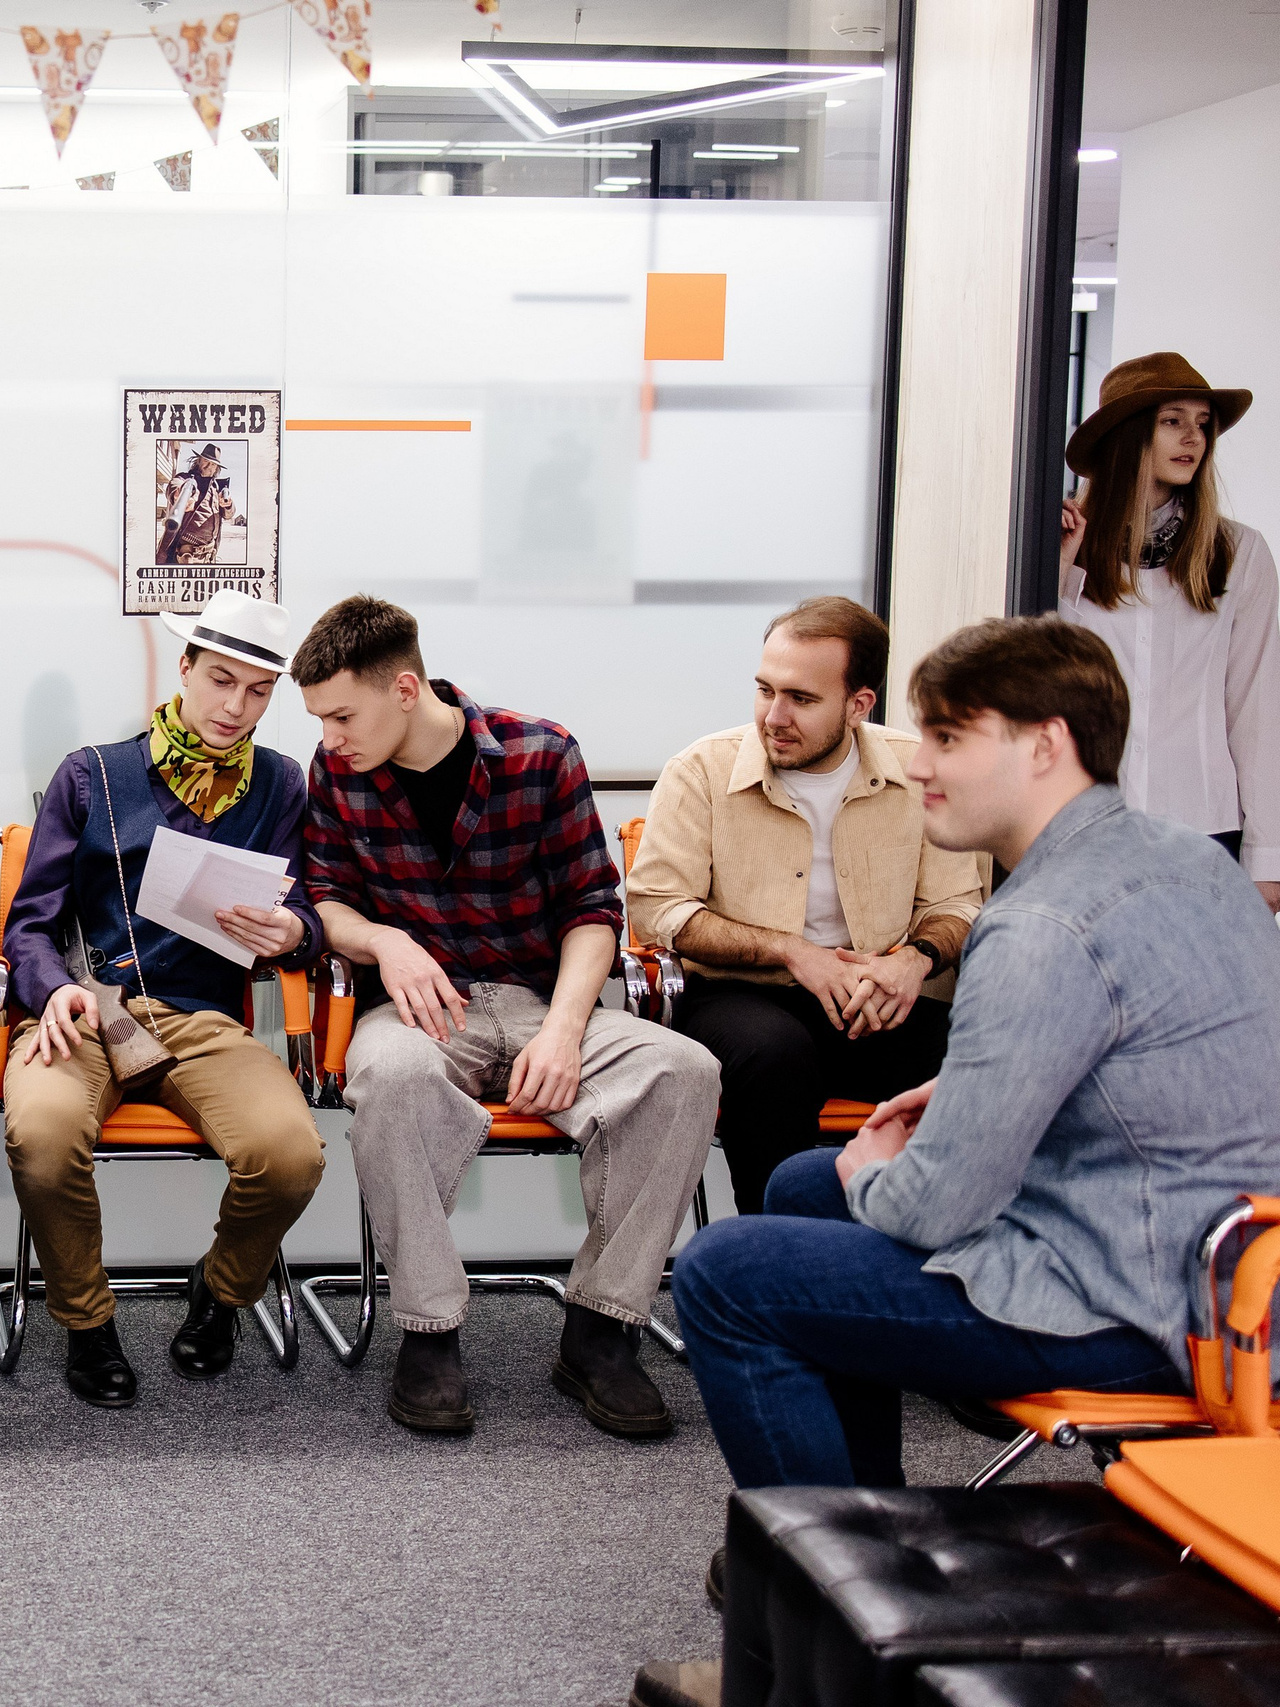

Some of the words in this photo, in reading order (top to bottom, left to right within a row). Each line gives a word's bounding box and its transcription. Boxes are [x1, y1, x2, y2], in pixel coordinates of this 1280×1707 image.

[139, 404, 266, 433] WANTED
[142, 568, 169, 578] ARMED
[172, 568, 188, 578] AND
[191, 568, 211, 578] VERY
[214, 568, 260, 578] DANGEROUS
[138, 581, 175, 594] CASH
[138, 595, 175, 603] REWARD
